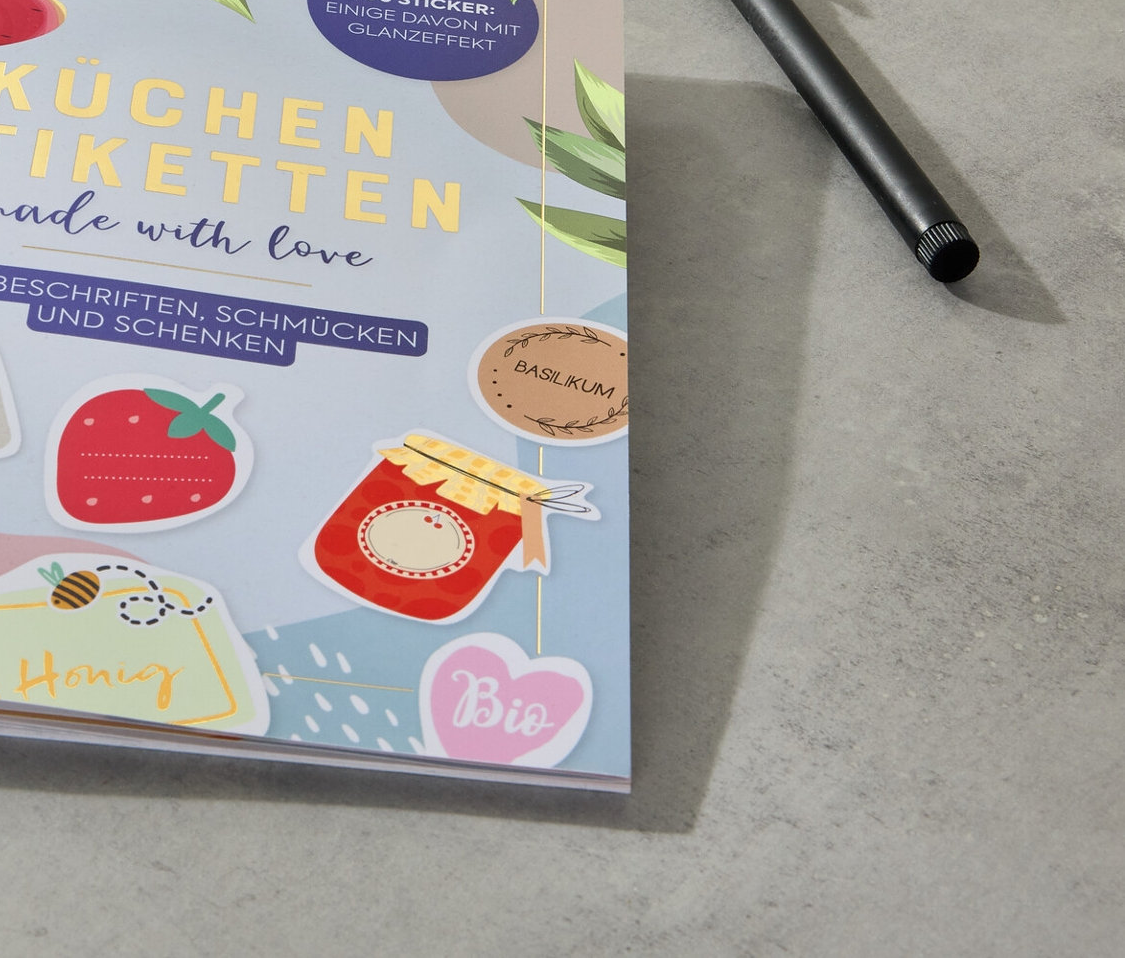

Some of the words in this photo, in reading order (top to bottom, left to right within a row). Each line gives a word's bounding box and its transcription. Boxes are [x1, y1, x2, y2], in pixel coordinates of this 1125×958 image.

[326, 1, 396, 21] EINIGE
[402, 11, 478, 31] DAVON
[485, 21, 521, 37] MIT
[347, 22, 497, 51] GLANZEFFEKT
[136, 219, 252, 255] with
[268, 225, 373, 267] love
[37, 305, 105, 327] UND
[114, 315, 286, 357] SCHENKEN
[216, 304, 418, 348] SCHMÜCKEN
[514, 359, 616, 399] BASILIKUM
[15, 650, 183, 710] Honig
[451, 670, 555, 736] Bio
